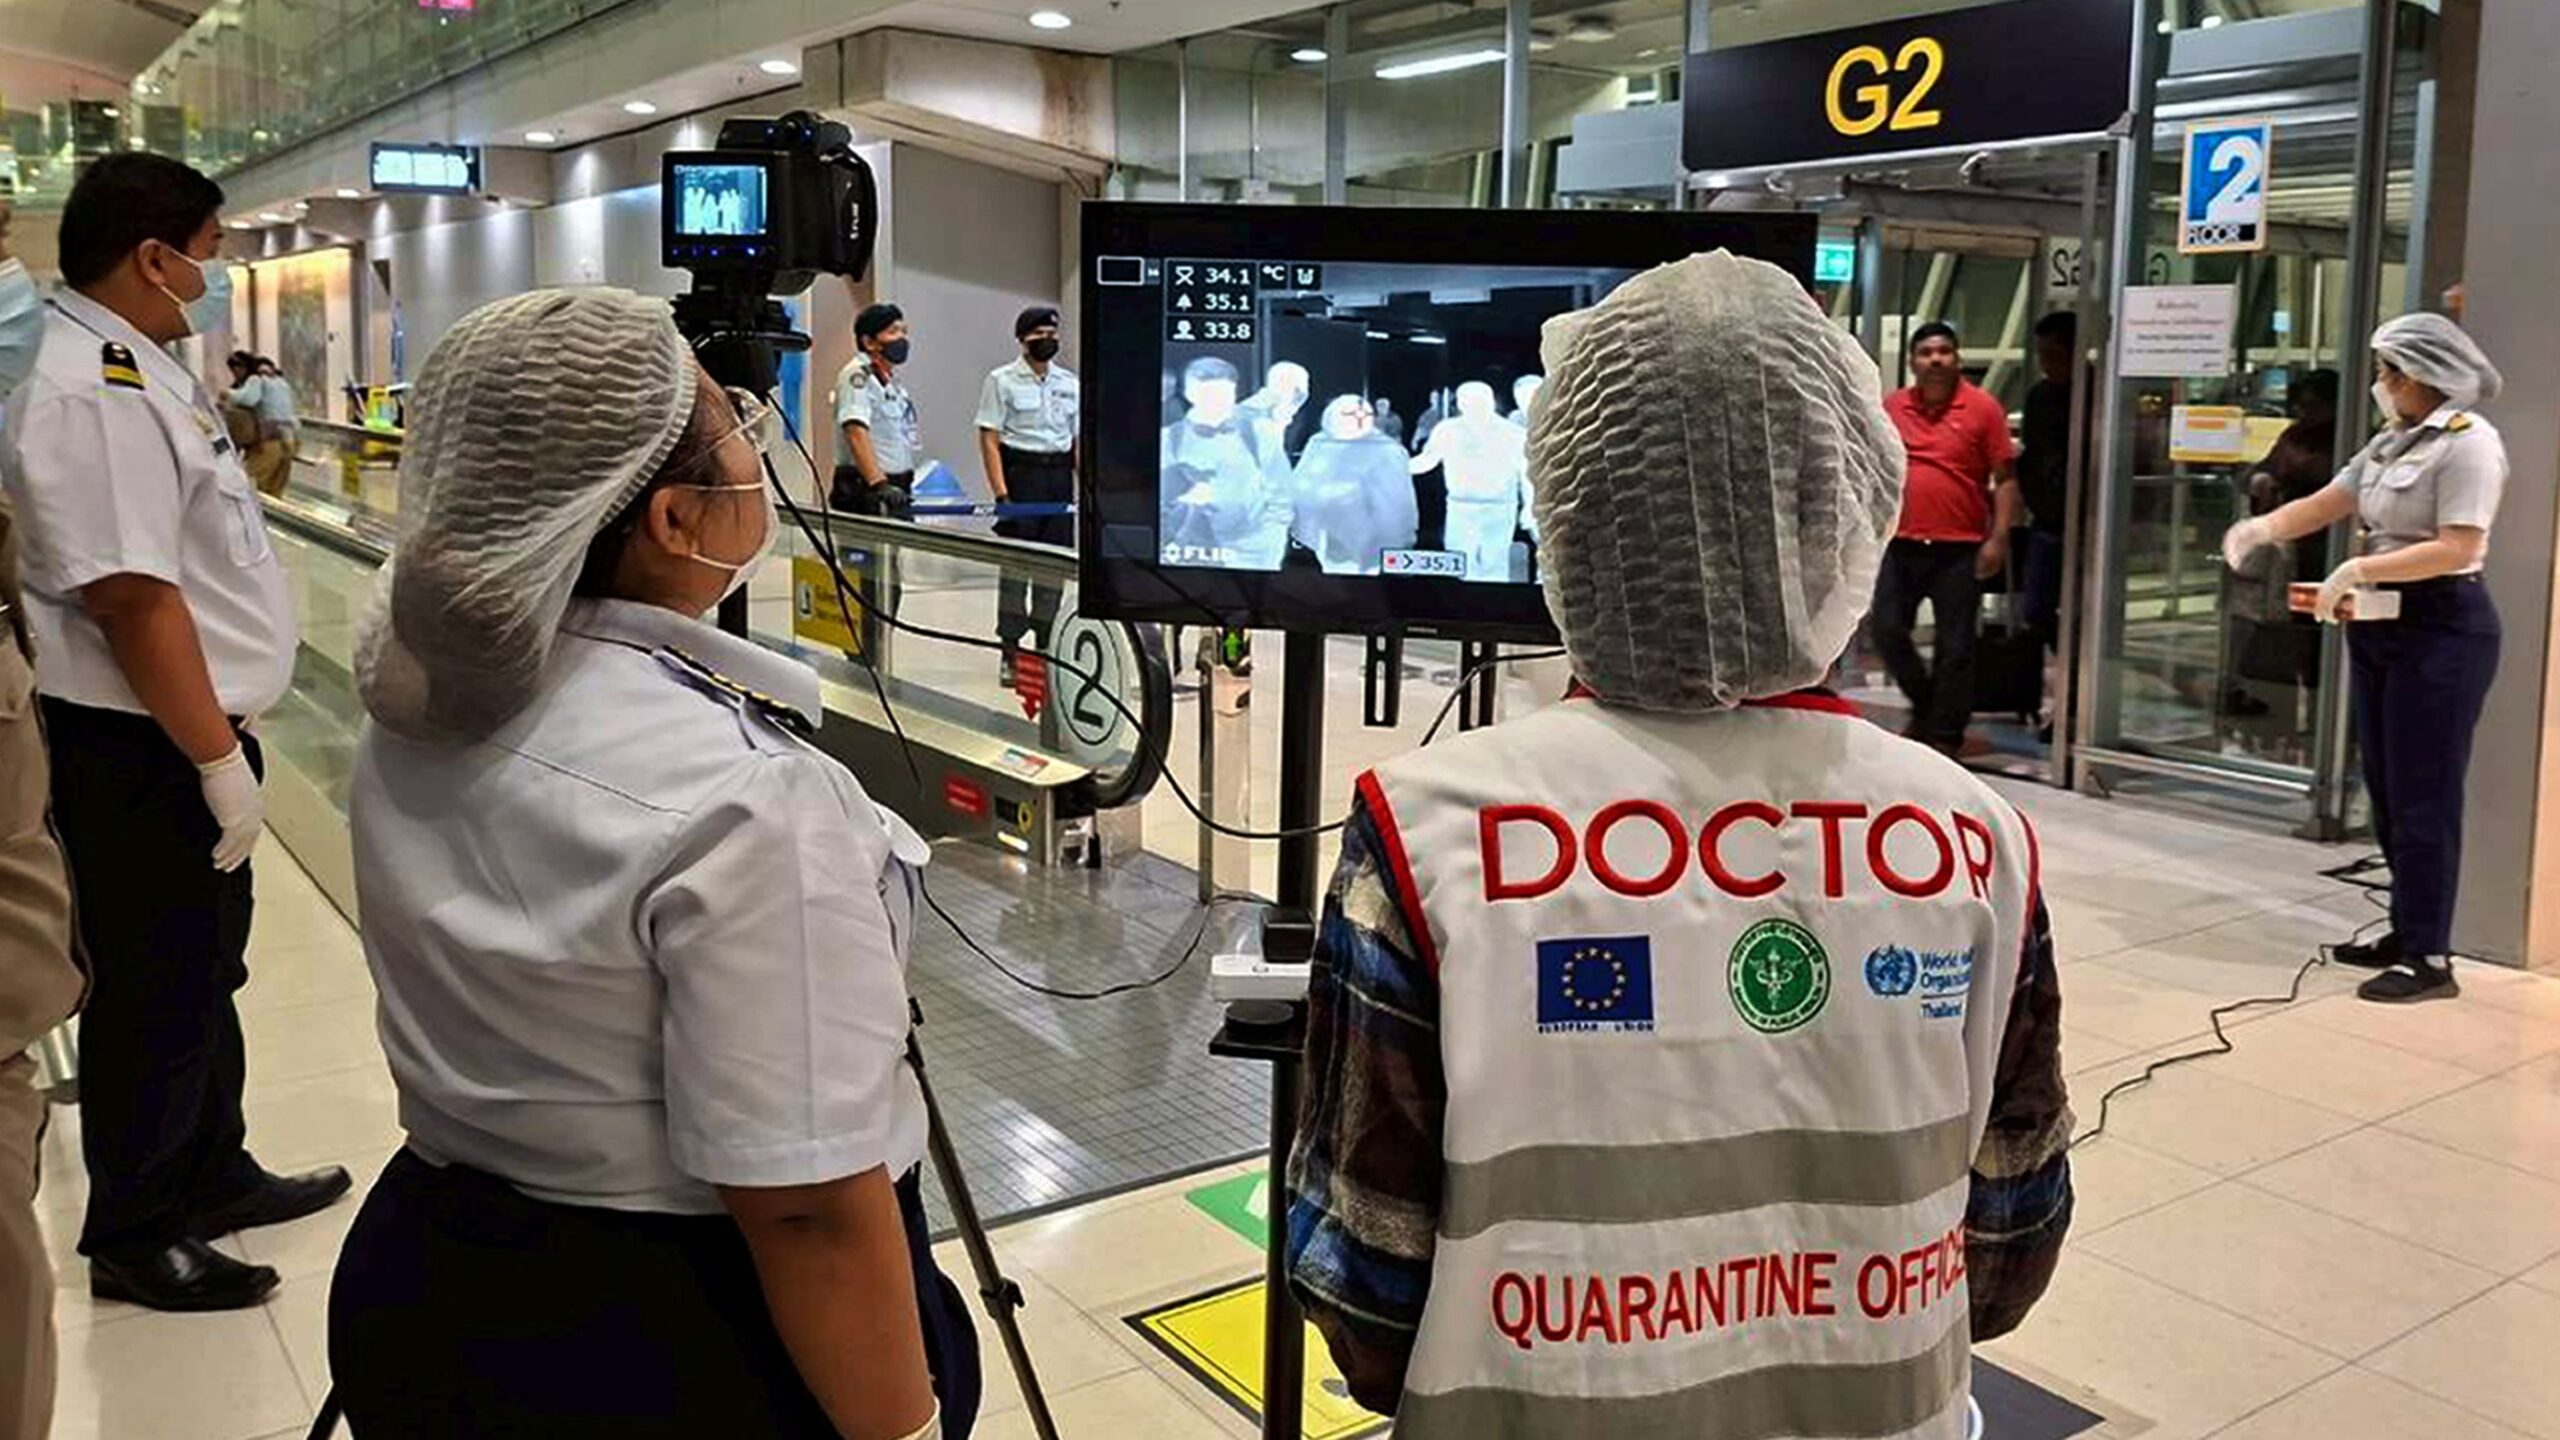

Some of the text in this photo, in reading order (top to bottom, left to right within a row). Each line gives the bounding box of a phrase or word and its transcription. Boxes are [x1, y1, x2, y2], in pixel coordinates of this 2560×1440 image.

[1826, 37, 1942, 136] G2
[2205, 134, 2262, 223] 2
[1204, 293, 1250, 310] 35.1
[1205, 267, 1250, 284] 34.1
[1204, 322, 1251, 339] 33.8
[1073, 629, 1103, 728] 2
[1479, 799, 1994, 901] DOCTOR
[1492, 1252, 1836, 1349] QUARANTINE
